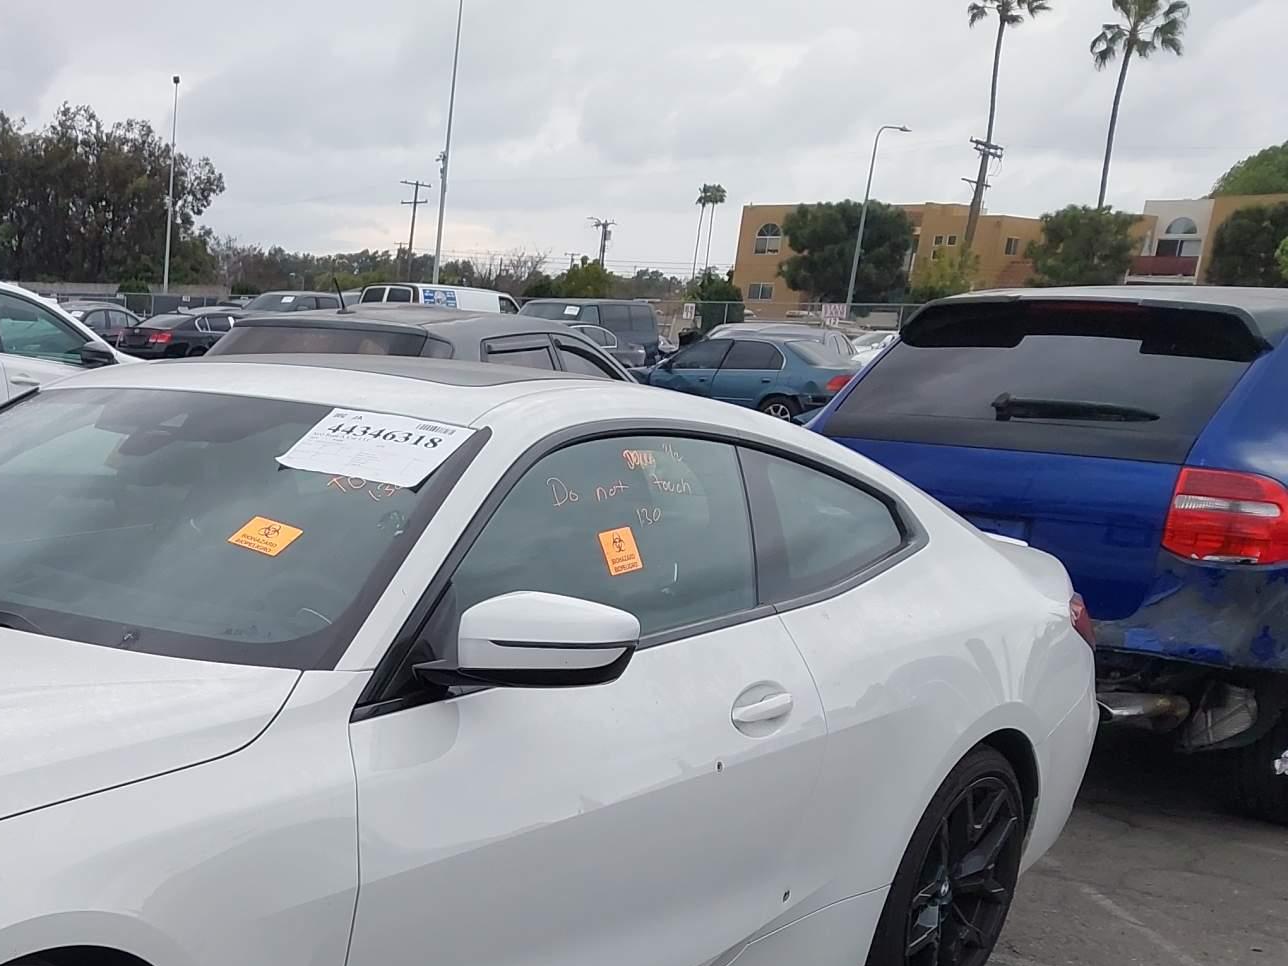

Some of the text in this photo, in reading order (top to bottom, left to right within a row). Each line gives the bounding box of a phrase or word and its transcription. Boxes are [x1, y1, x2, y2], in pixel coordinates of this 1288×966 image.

[328, 422, 443, 449] 44346318
[546, 476, 580, 508] Do
[595, 479, 630, 502] not
